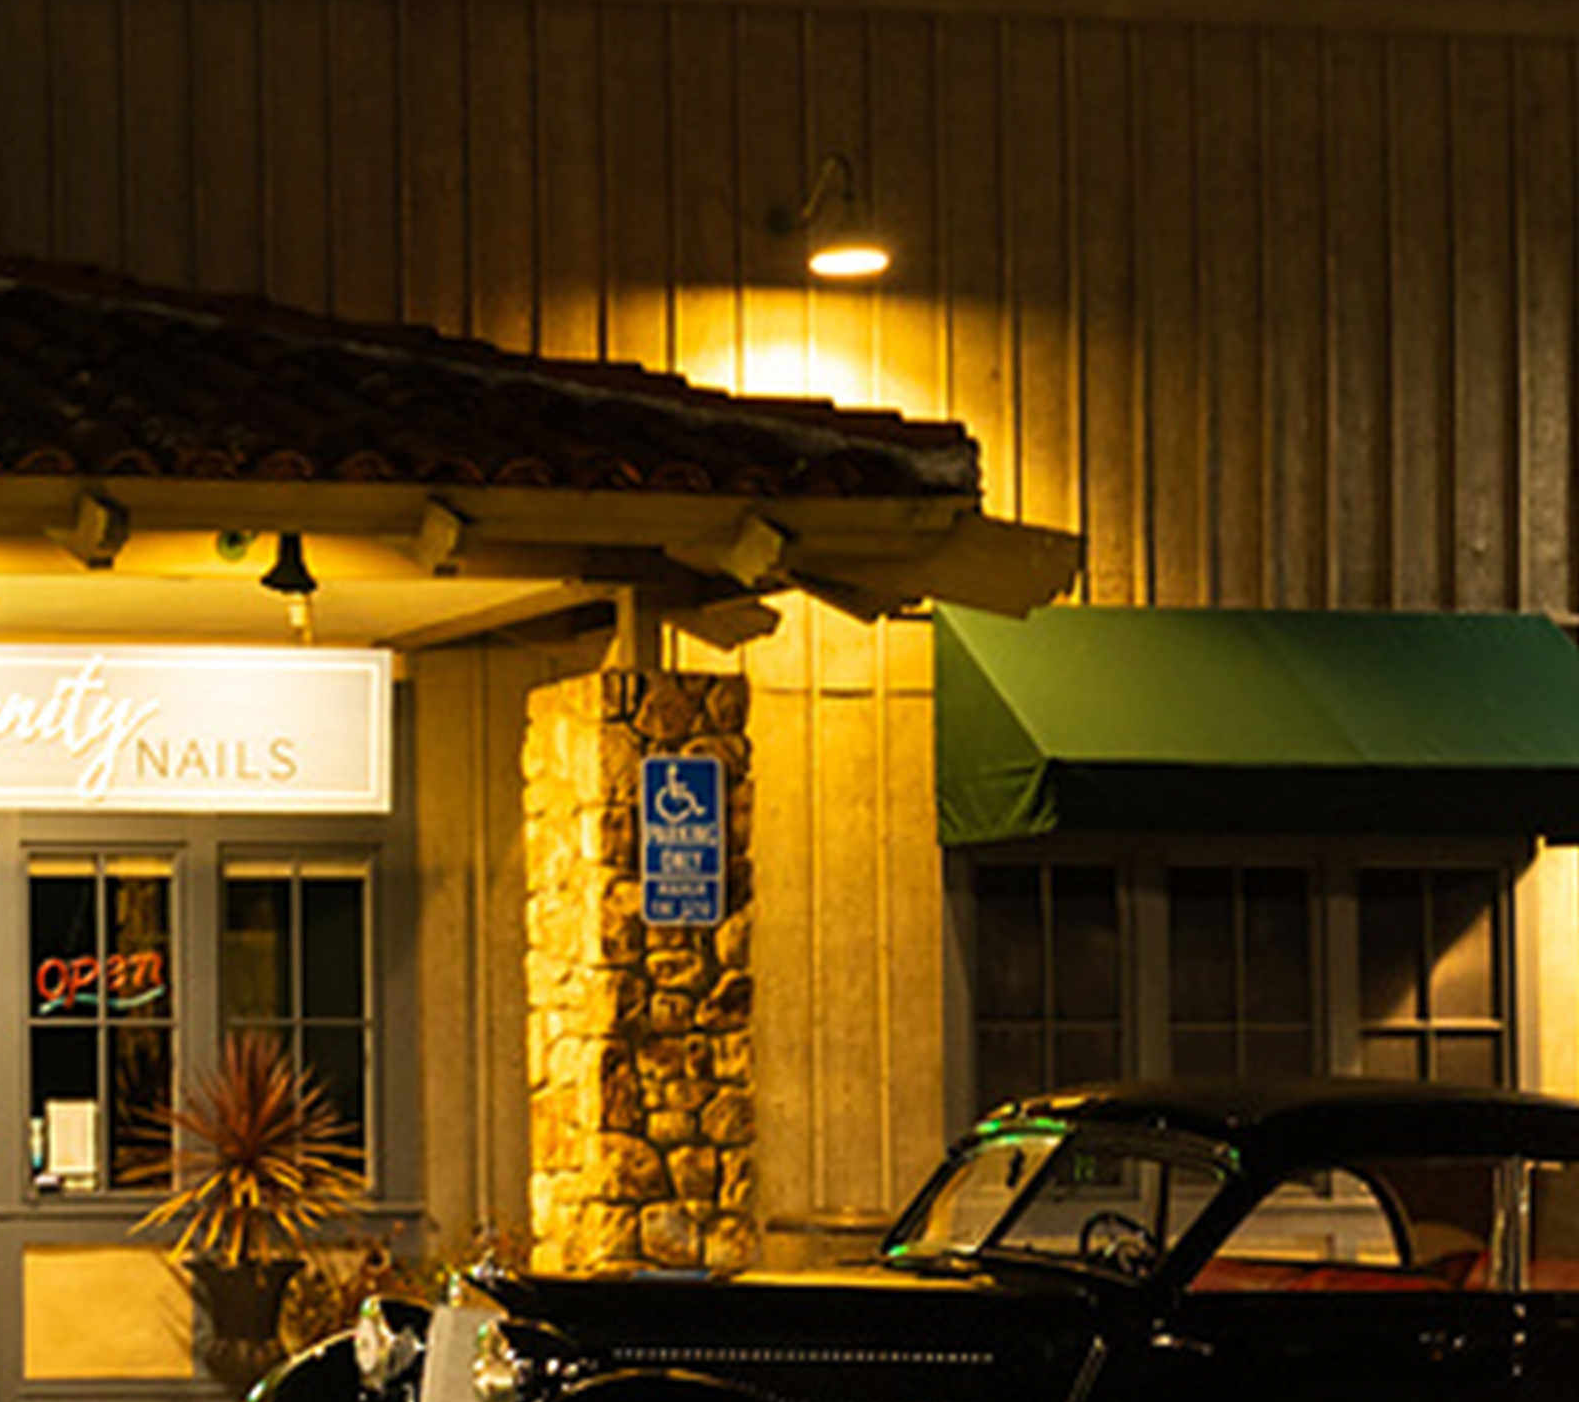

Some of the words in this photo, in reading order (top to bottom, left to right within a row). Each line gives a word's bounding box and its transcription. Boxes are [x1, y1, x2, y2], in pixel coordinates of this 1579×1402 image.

[134, 738, 299, 781] NAILS
[647, 823, 719, 847] PARKING
[661, 850, 703, 876] ONLY
